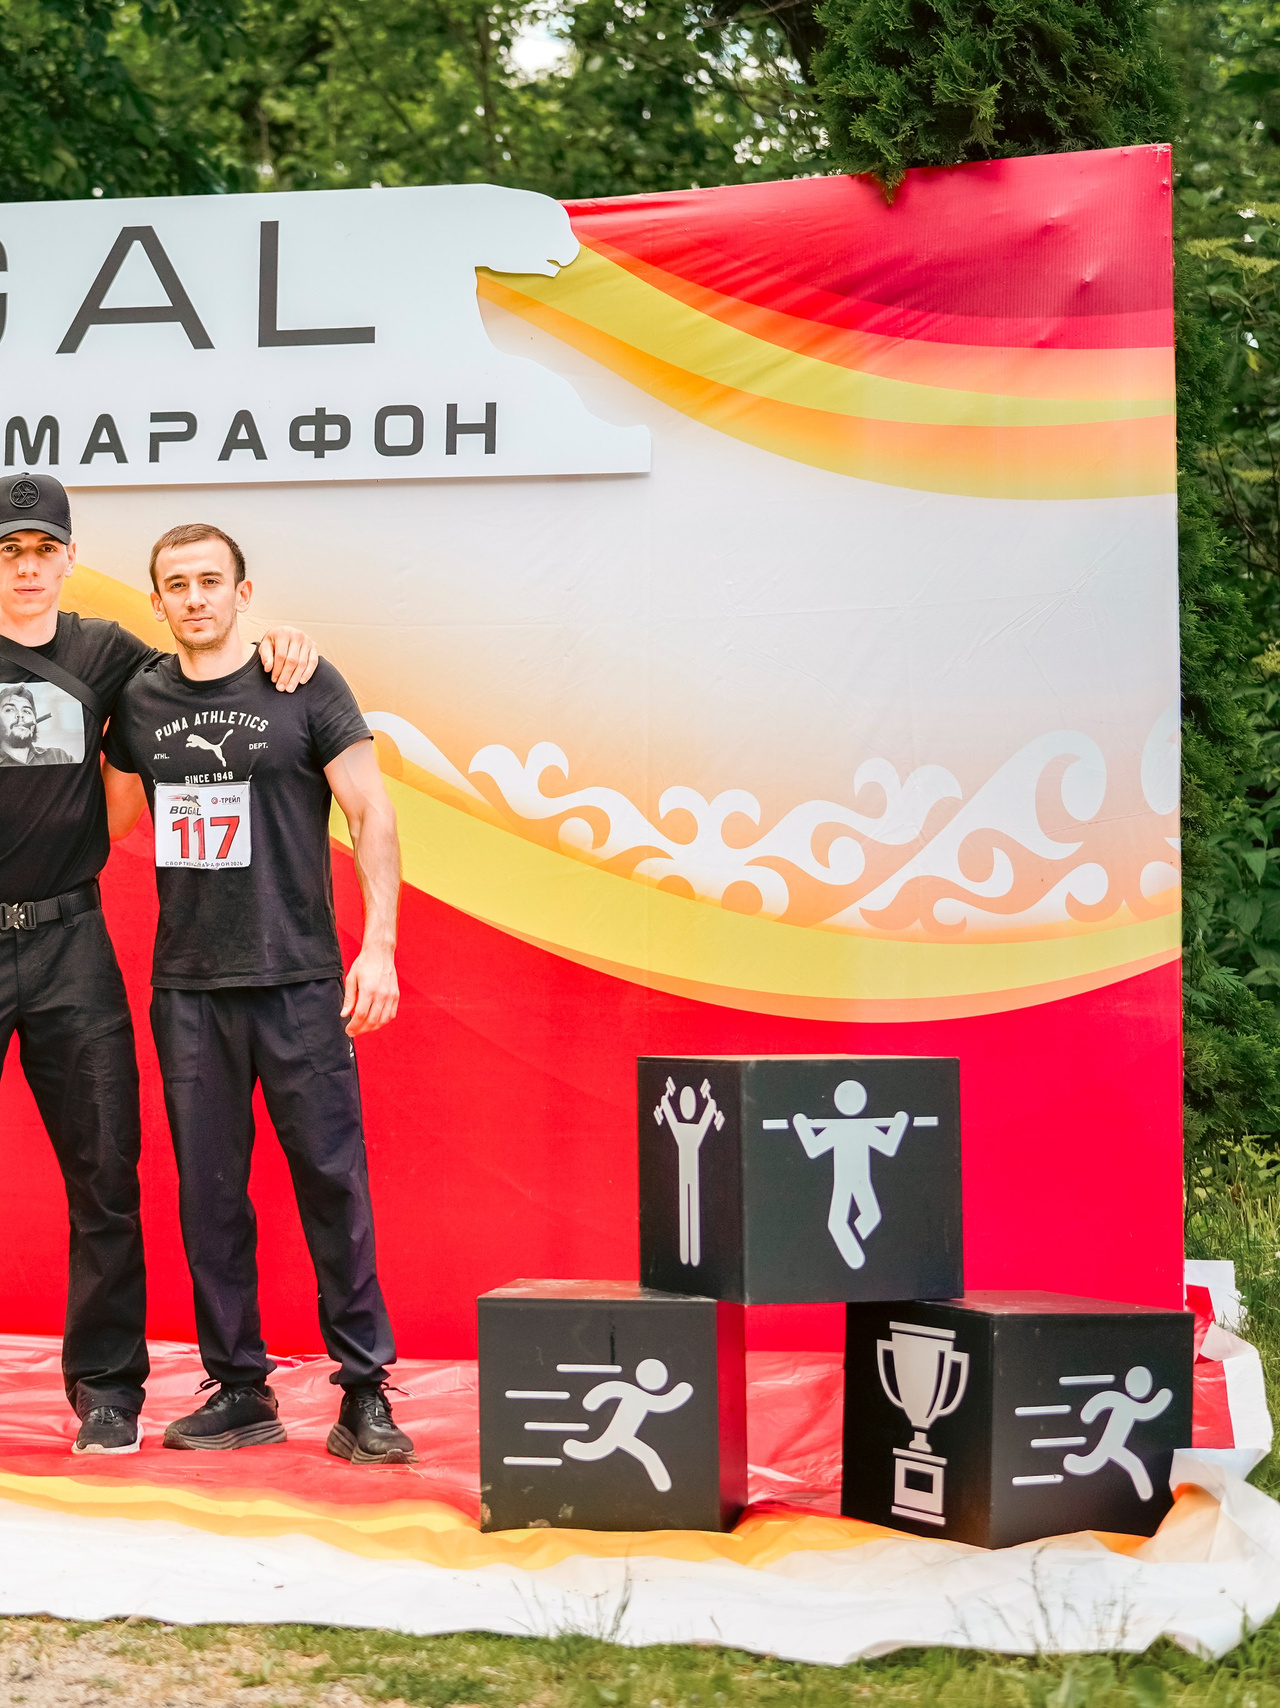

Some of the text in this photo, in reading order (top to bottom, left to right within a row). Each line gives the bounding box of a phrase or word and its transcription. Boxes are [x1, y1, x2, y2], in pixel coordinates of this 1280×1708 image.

[3, 402, 497, 467] МАРАФОН
[154, 710, 269, 742] PUMA ATHLETICS
[248, 742, 268, 750] DEPT.
[185, 771, 233, 784] SINCE 1948
[169, 806, 202, 816] BOGAL
[172, 816, 240, 861] 117
